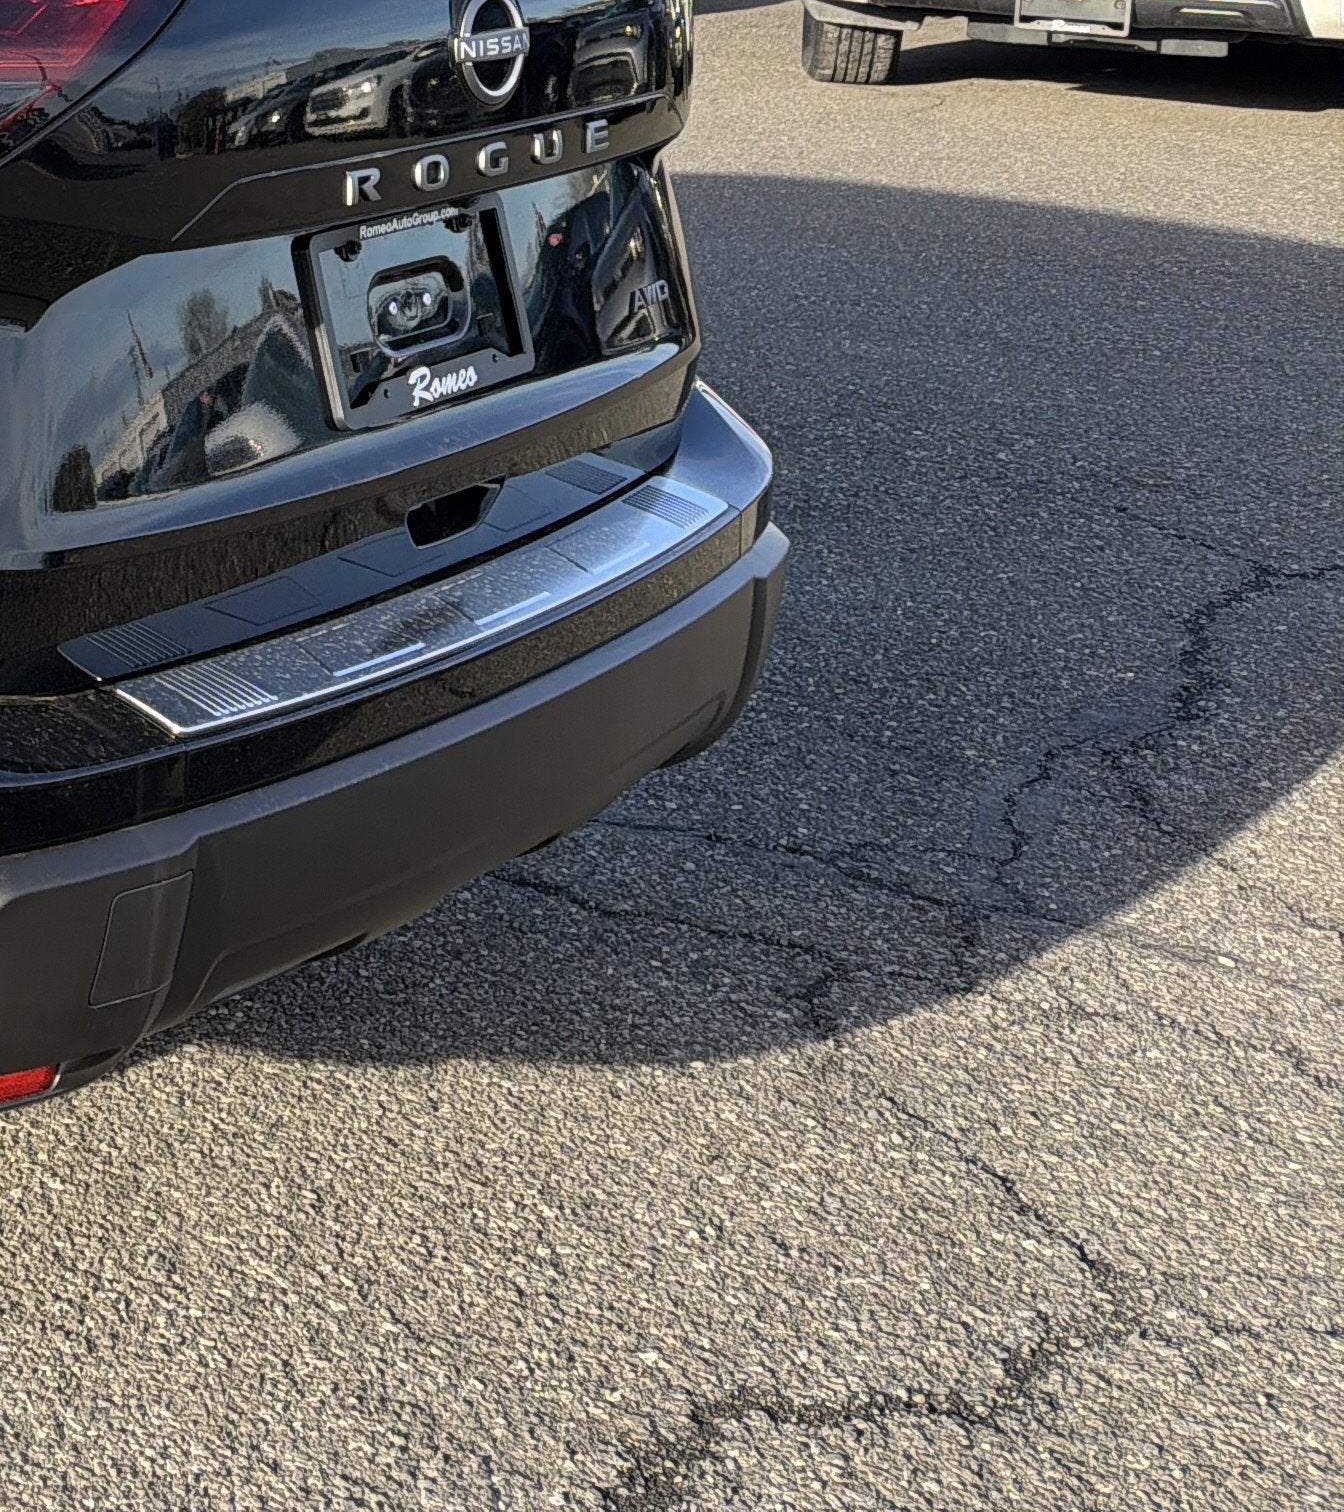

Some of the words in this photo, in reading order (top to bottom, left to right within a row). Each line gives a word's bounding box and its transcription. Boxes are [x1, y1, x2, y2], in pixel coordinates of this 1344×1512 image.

[459, 32, 530, 60] NISSAN
[342, 118, 611, 207] ROGUE
[359, 206, 460, 240] RomeoAutoGroup.com
[408, 365, 478, 407] Romeo
